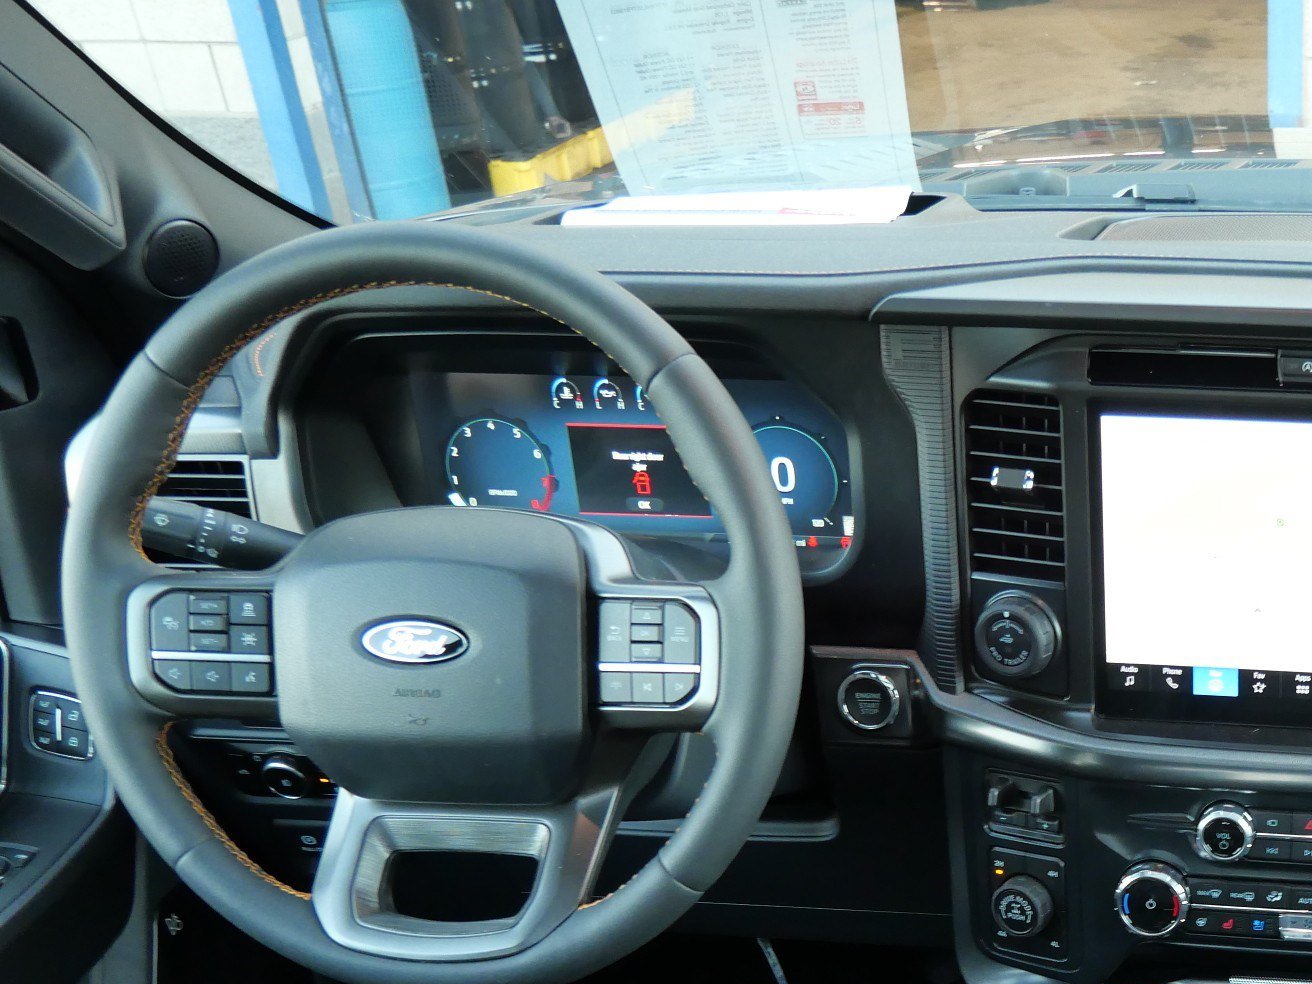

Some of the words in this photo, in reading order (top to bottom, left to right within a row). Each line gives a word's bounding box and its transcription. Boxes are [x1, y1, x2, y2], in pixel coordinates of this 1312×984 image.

[487, 421, 495, 430] 4
[464, 427, 472, 437] 3
[513, 429, 521, 439] 5
[450, 447, 459, 457] 2
[533, 449, 542, 459] 6
[771, 456, 796, 492] 0
[382, 626, 448, 655] Ford
[990, 647, 1003, 661] PRO
[1120, 665, 1138, 673] Audio
[1162, 667, 1182, 675] Phone
[1253, 671, 1266, 680] Fav
[1295, 674, 1311, 683] Apps
[393, 688, 441, 698] AIRBAG
[1216, 832, 1231, 840] VOL
[994, 859, 1005, 868] 2H
